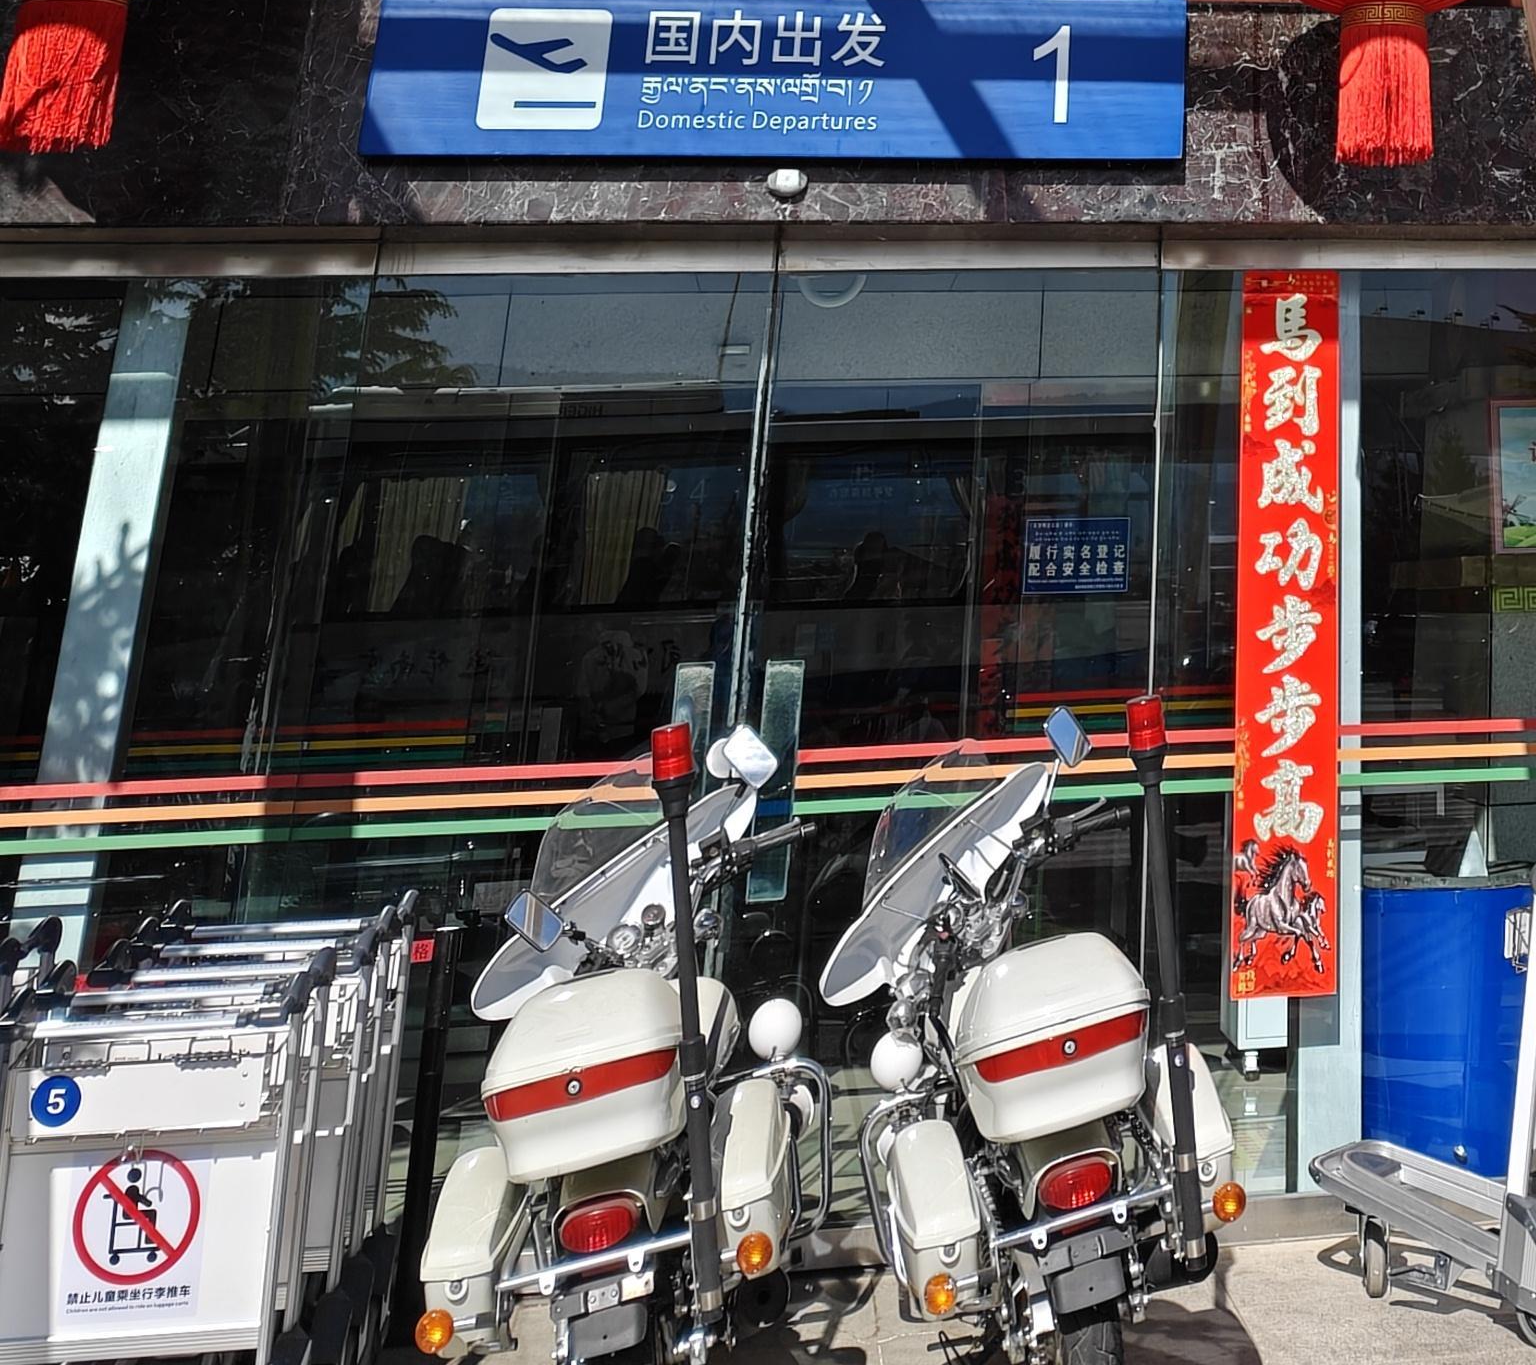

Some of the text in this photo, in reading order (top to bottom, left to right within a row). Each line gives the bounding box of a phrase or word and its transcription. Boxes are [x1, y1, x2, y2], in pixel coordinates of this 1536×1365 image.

[644, 9, 887, 67] 国内出发
[1032, 24, 1073, 125] 1
[637, 110, 878, 134] Domestic Departures
[1028, 542, 1125, 560] 履行实名登记
[1027, 561, 1125, 577] 配合安全检查
[46, 1087, 66, 1116] 5
[66, 1285, 191, 1305] 禁止儿童乘坐行李推车
